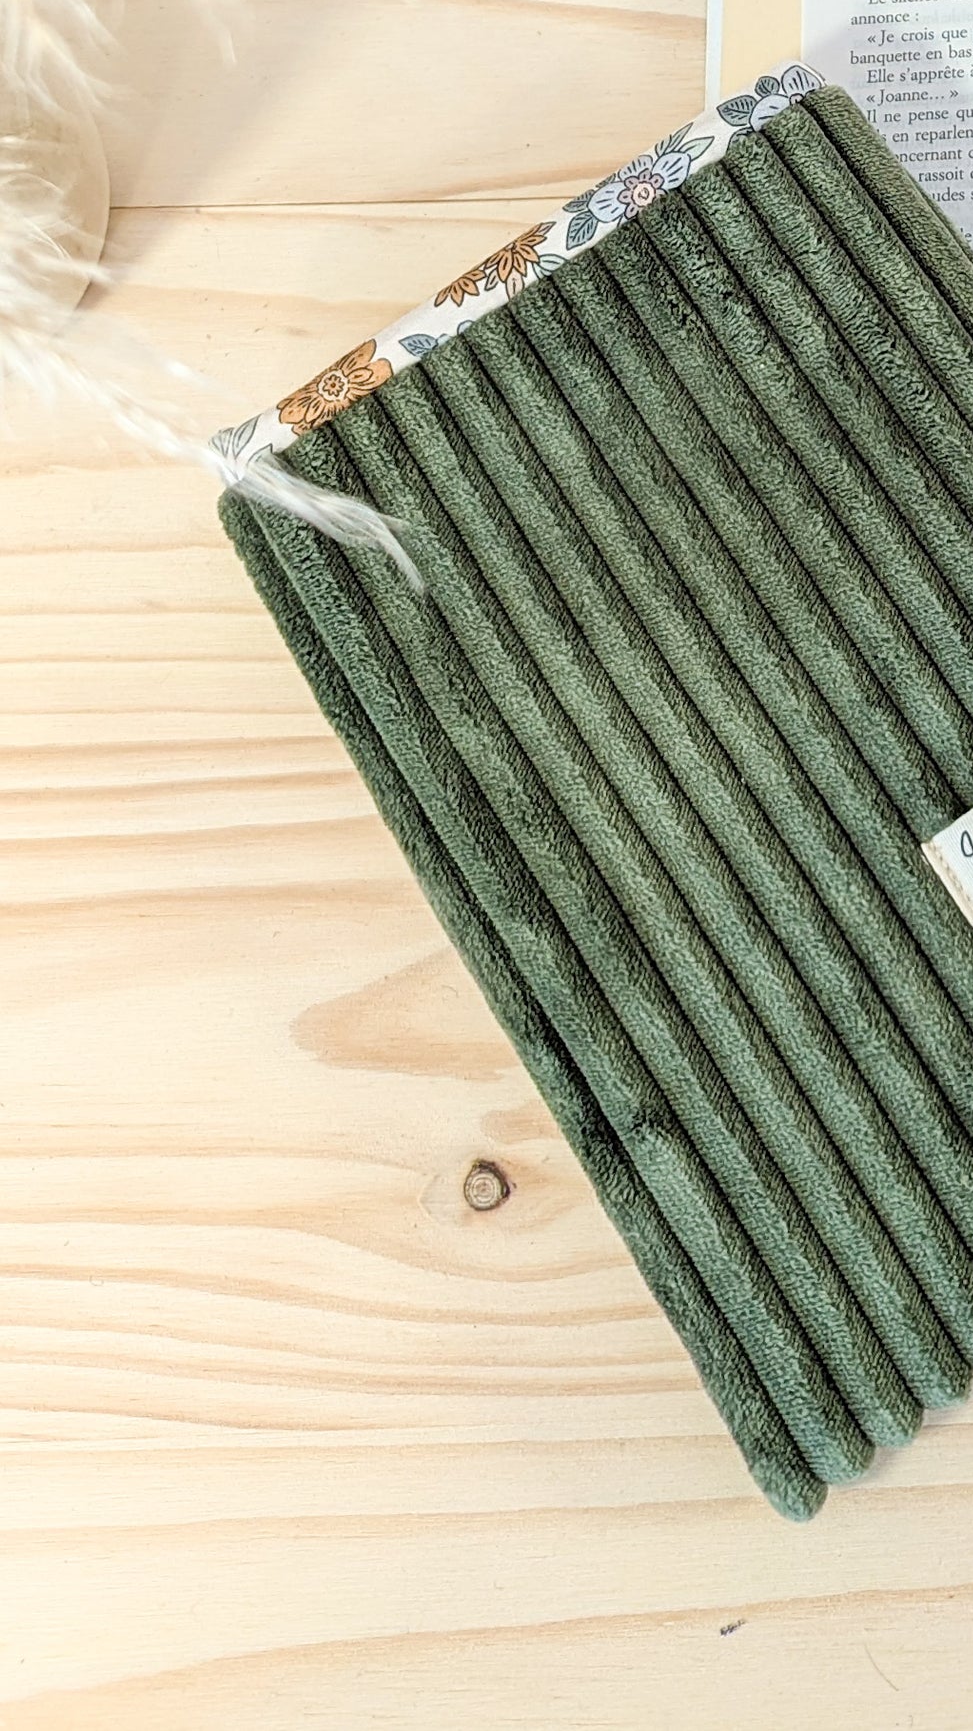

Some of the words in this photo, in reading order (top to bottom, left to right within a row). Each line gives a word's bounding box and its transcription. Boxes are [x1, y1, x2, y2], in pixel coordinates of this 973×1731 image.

[850, 50, 921, 67] banquette
[925, 50, 943, 61] en
[866, 68, 895, 84] Elle
[899, 65, 965, 85] s'apprête
[891, 132, 909, 143] en
[918, 166, 965, 183] rassoit
